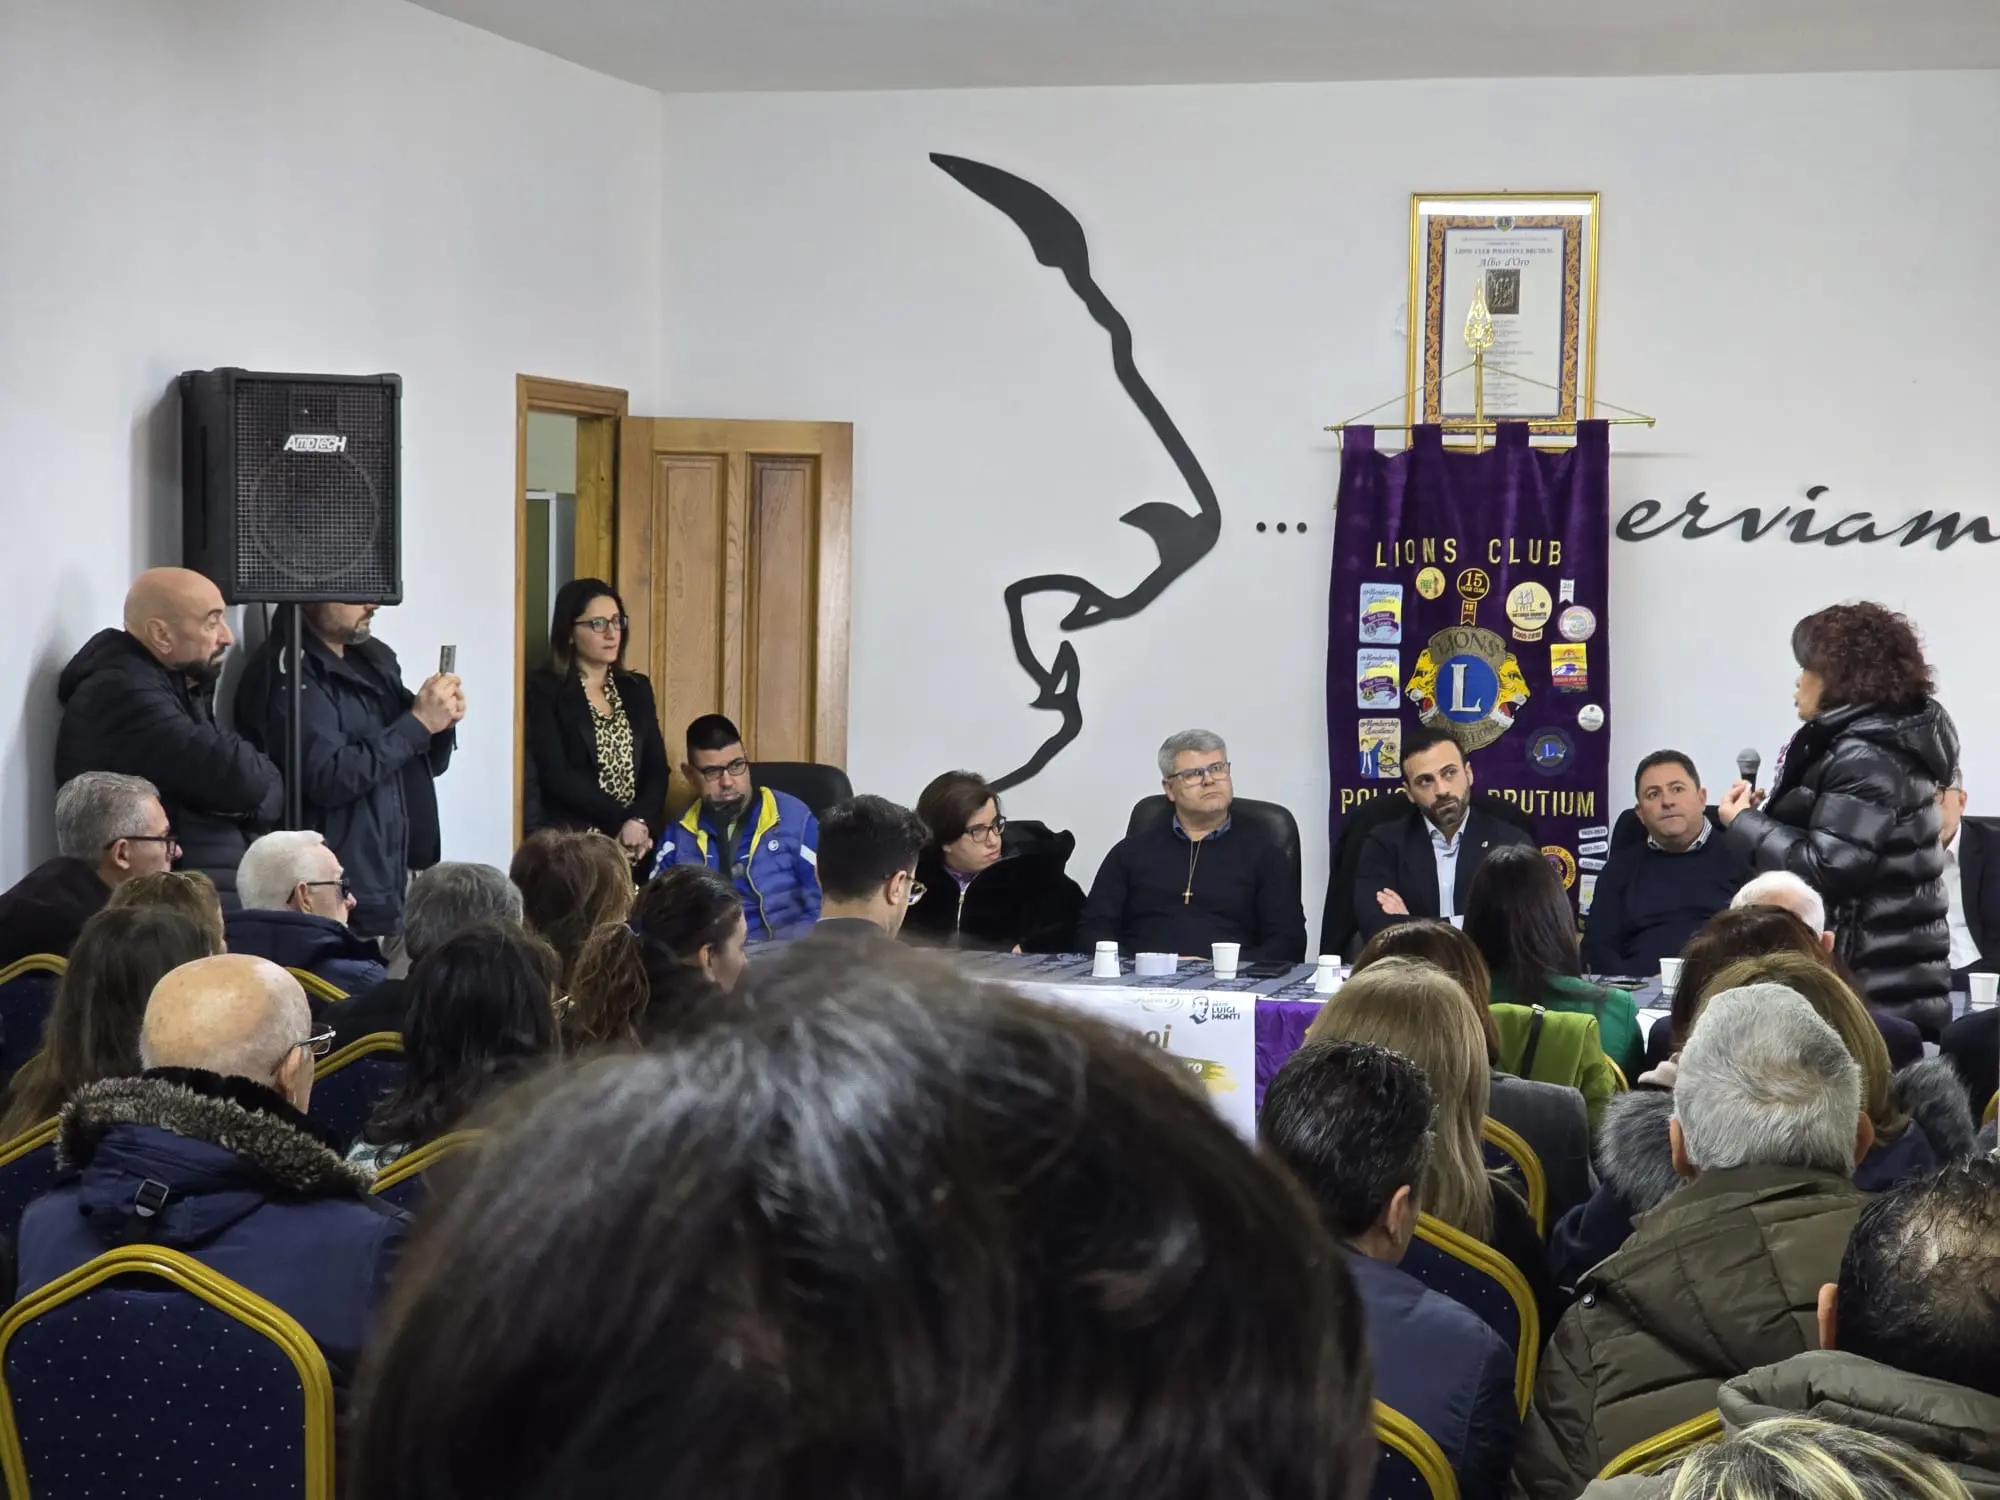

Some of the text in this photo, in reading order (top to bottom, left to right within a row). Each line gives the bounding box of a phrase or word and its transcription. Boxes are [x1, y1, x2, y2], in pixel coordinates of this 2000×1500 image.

[1375, 537, 1563, 568] LIONS CLUB
[1465, 571, 1484, 588] 15
[1436, 631, 1501, 657] LIONS
[1449, 663, 1482, 713] L
[1211, 1006, 1236, 1014] LUIGI
[1211, 1013, 1241, 1021] MONTI
